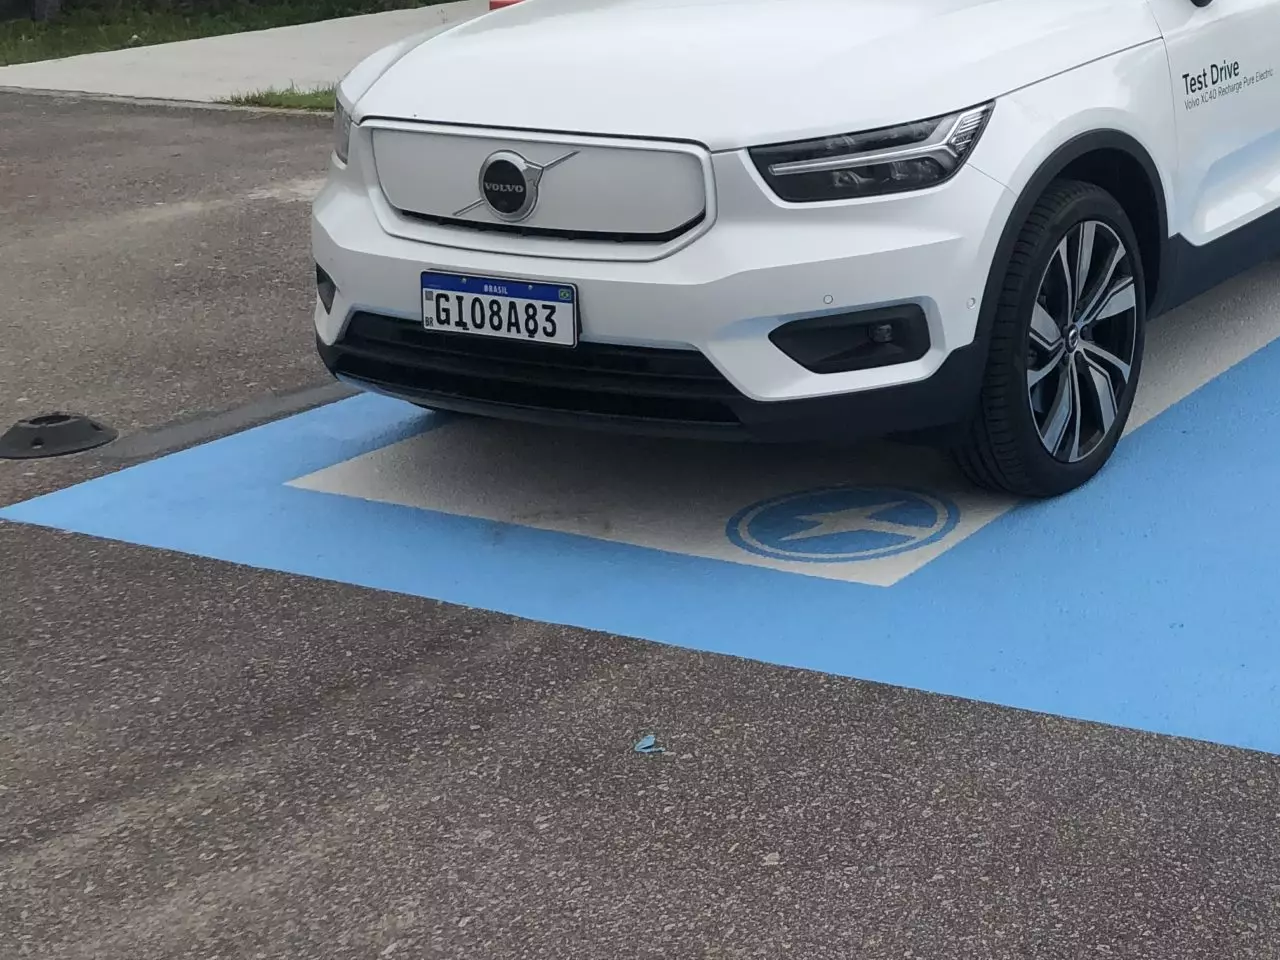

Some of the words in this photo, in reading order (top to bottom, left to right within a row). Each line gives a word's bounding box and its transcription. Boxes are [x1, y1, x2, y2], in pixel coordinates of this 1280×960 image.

[1182, 68, 1208, 95] Test
[1210, 60, 1239, 85] Drive
[1184, 97, 1200, 111] Volvo
[1201, 88, 1217, 104] XC40
[1218, 81, 1242, 96] Recharge
[1243, 76, 1255, 88] Pure
[1255, 68, 1274, 82] Electric
[485, 182, 525, 192] VOLVO
[484, 284, 508, 295] BRASIL
[425, 317, 434, 327] BR
